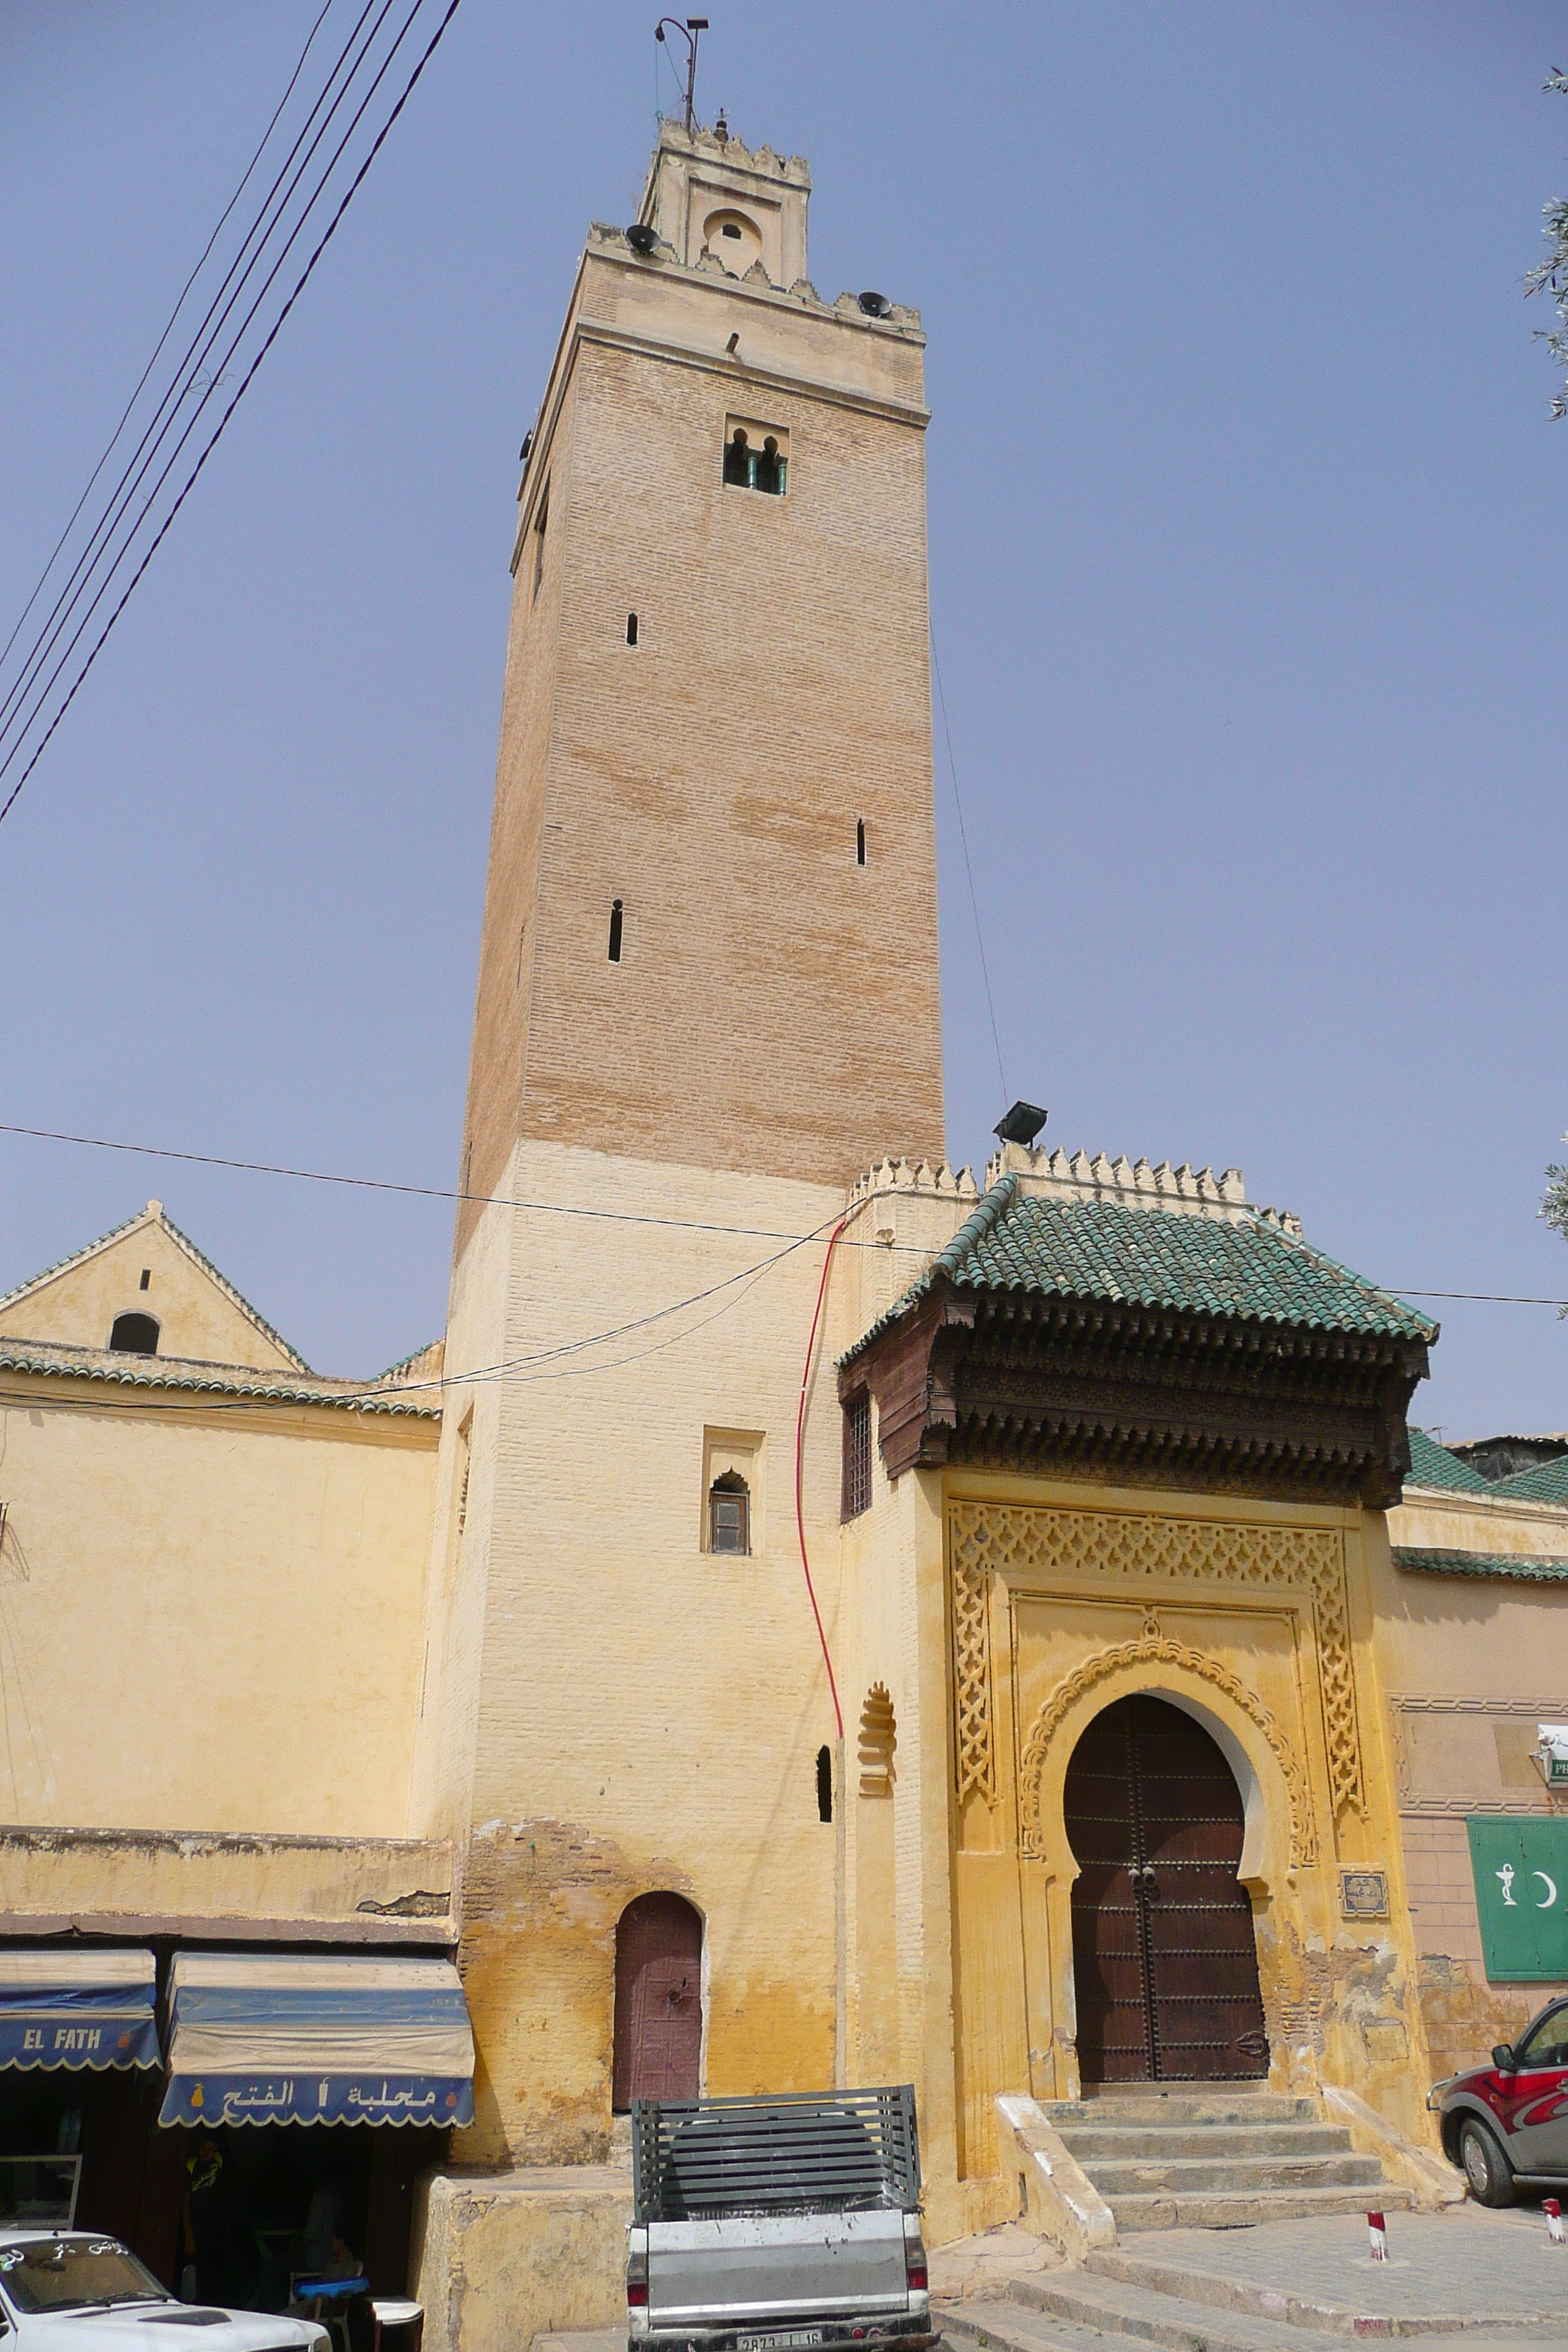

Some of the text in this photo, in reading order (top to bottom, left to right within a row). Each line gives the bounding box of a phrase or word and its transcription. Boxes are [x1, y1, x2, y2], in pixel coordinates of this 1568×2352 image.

[23, 2029, 102, 2049] EL FATH
[222, 2080, 437, 2118] محلبة الفتح
